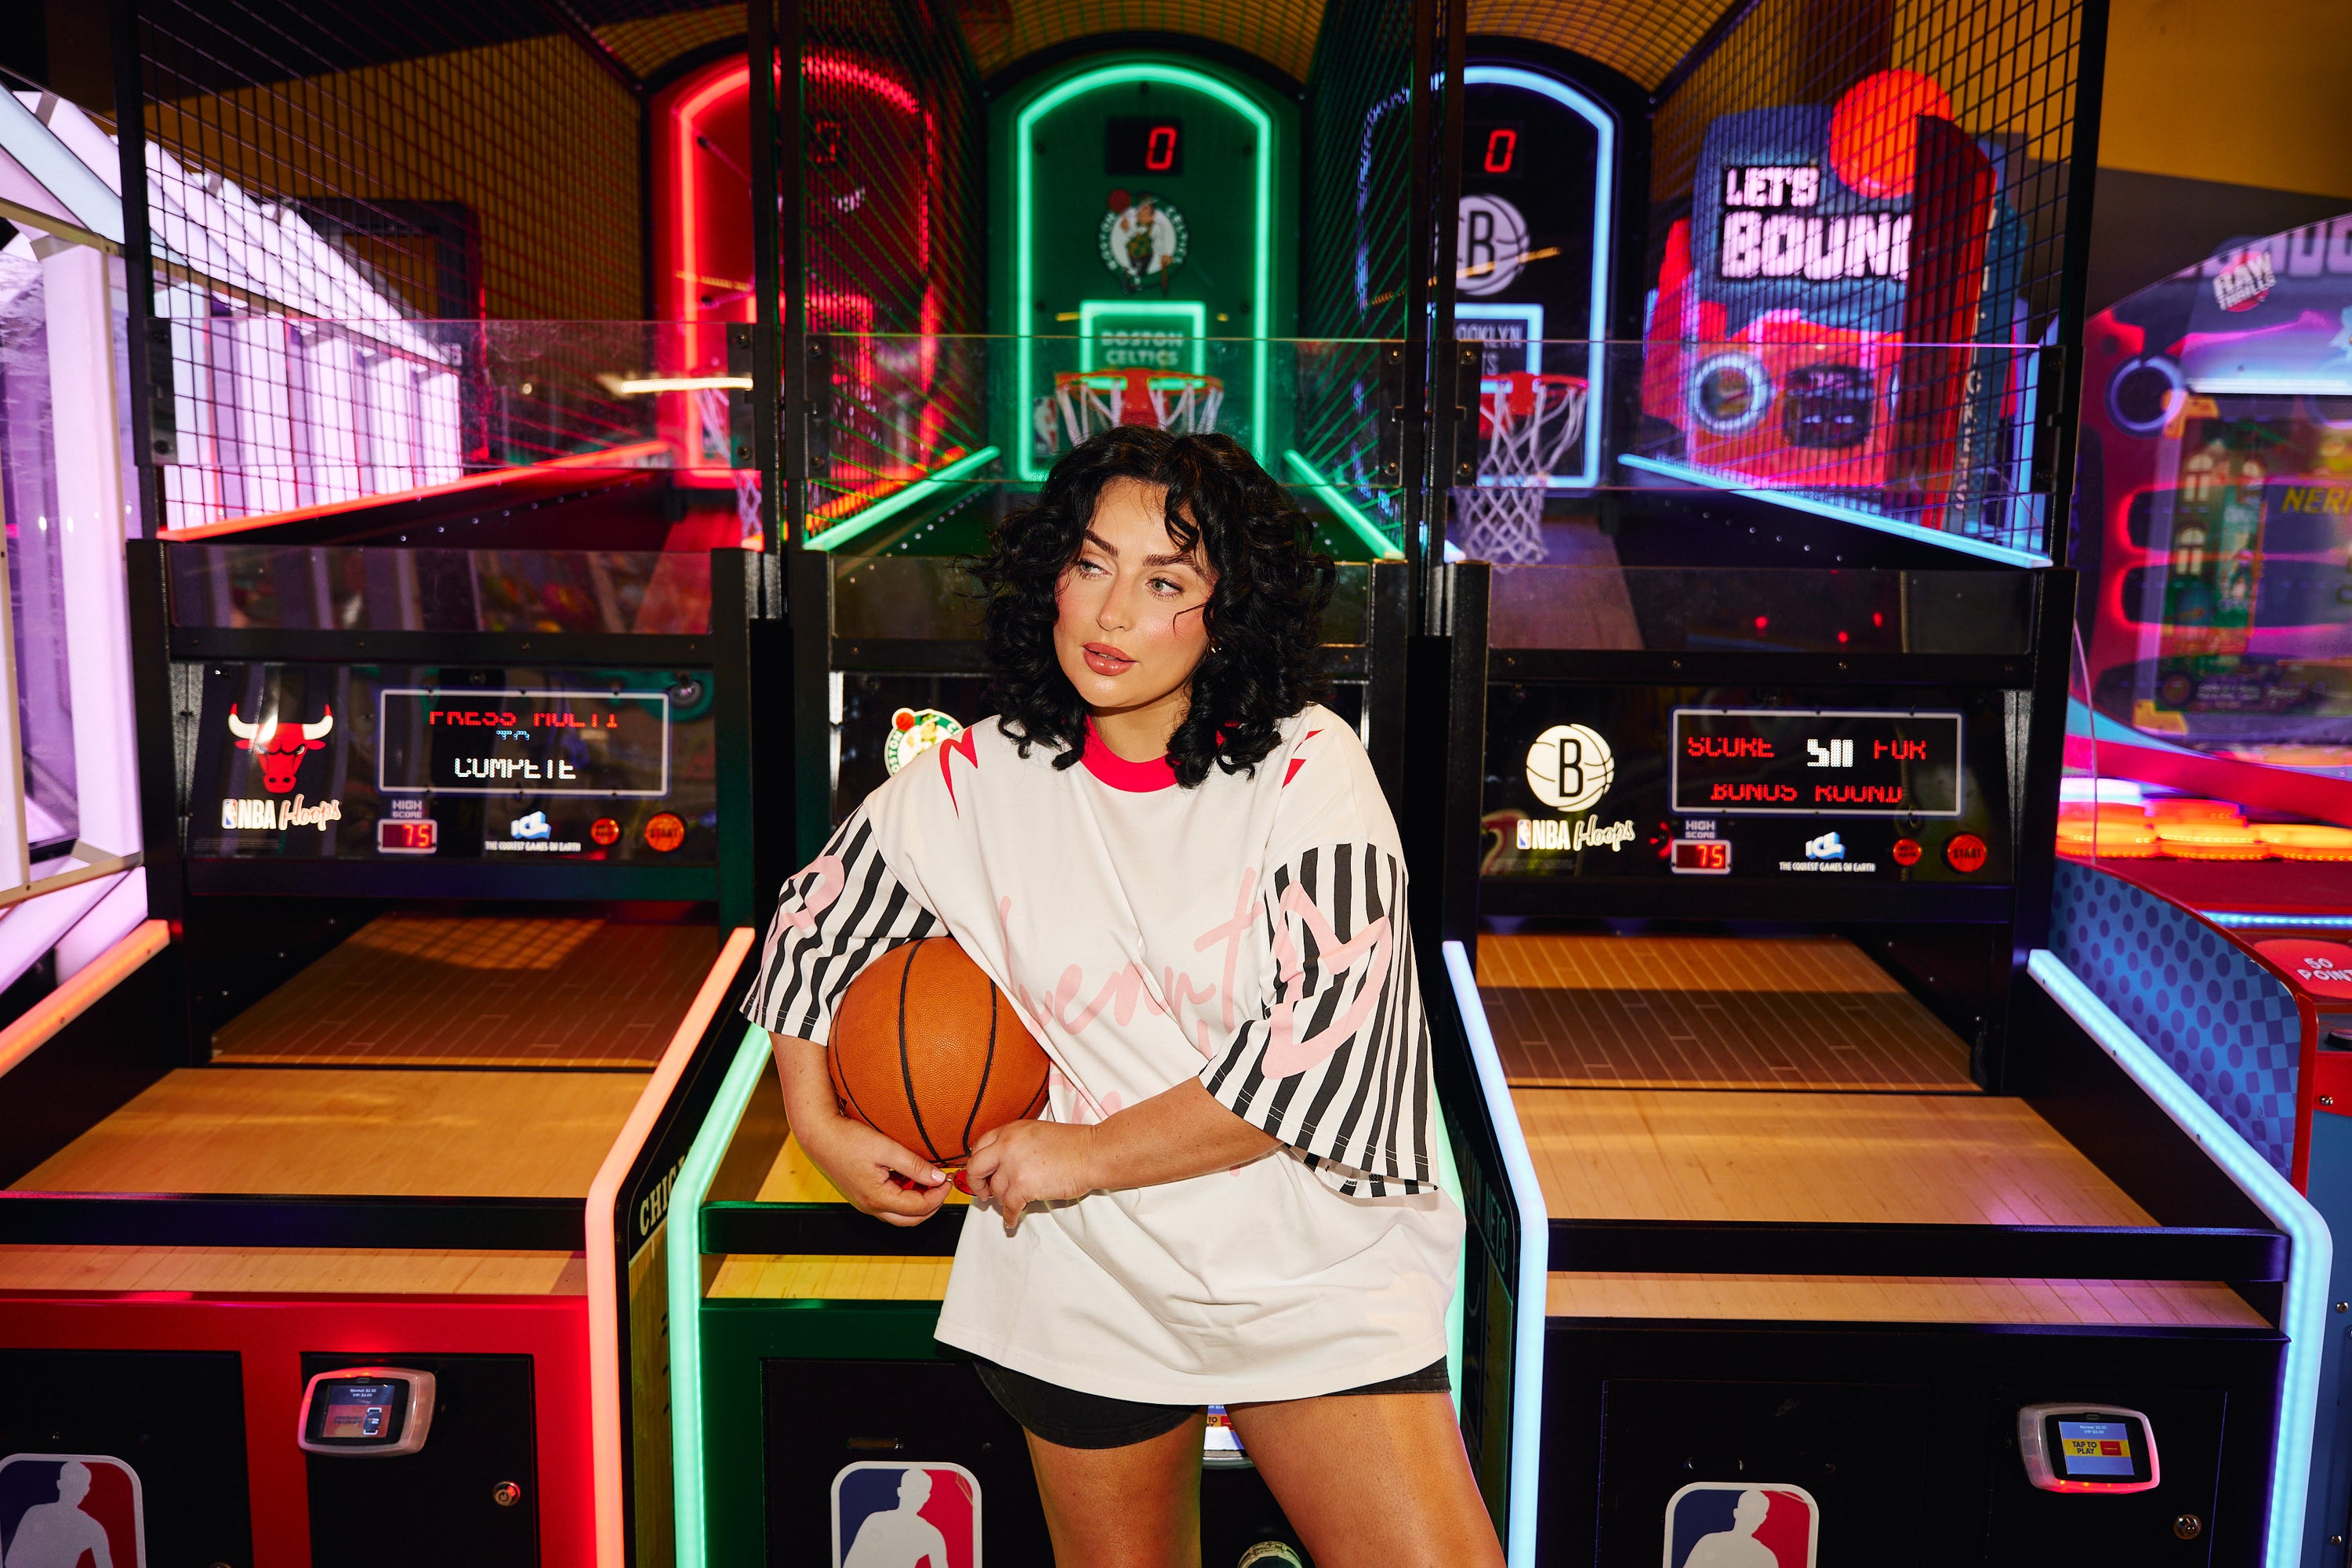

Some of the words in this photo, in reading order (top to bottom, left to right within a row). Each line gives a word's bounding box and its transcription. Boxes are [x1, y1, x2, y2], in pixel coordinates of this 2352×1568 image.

[1145, 126, 1177, 171] 0
[1485, 129, 1517, 172] 0
[1725, 165, 1820, 207] LET'S
[1721, 209, 1913, 281] BOUN
[2213, 251, 2273, 298] RAW
[1101, 330, 1184, 347] BOSTON
[1456, 323, 1523, 349] OOKLYN
[236, 798, 277, 829] NBA
[278, 793, 342, 832] Hoops
[392, 800, 423, 811] HIGH
[401, 824, 430, 848] 75
[510, 811, 552, 840] ICE
[1531, 819, 1571, 851] NBA
[1573, 814, 1636, 852] Hoops
[1685, 820, 1716, 831] HIGH
[1685, 831, 1716, 840] SCORE
[1696, 844, 1725, 868] 75
[1805, 831, 1846, 860] ICE
[2303, 957, 2333, 970] 50
